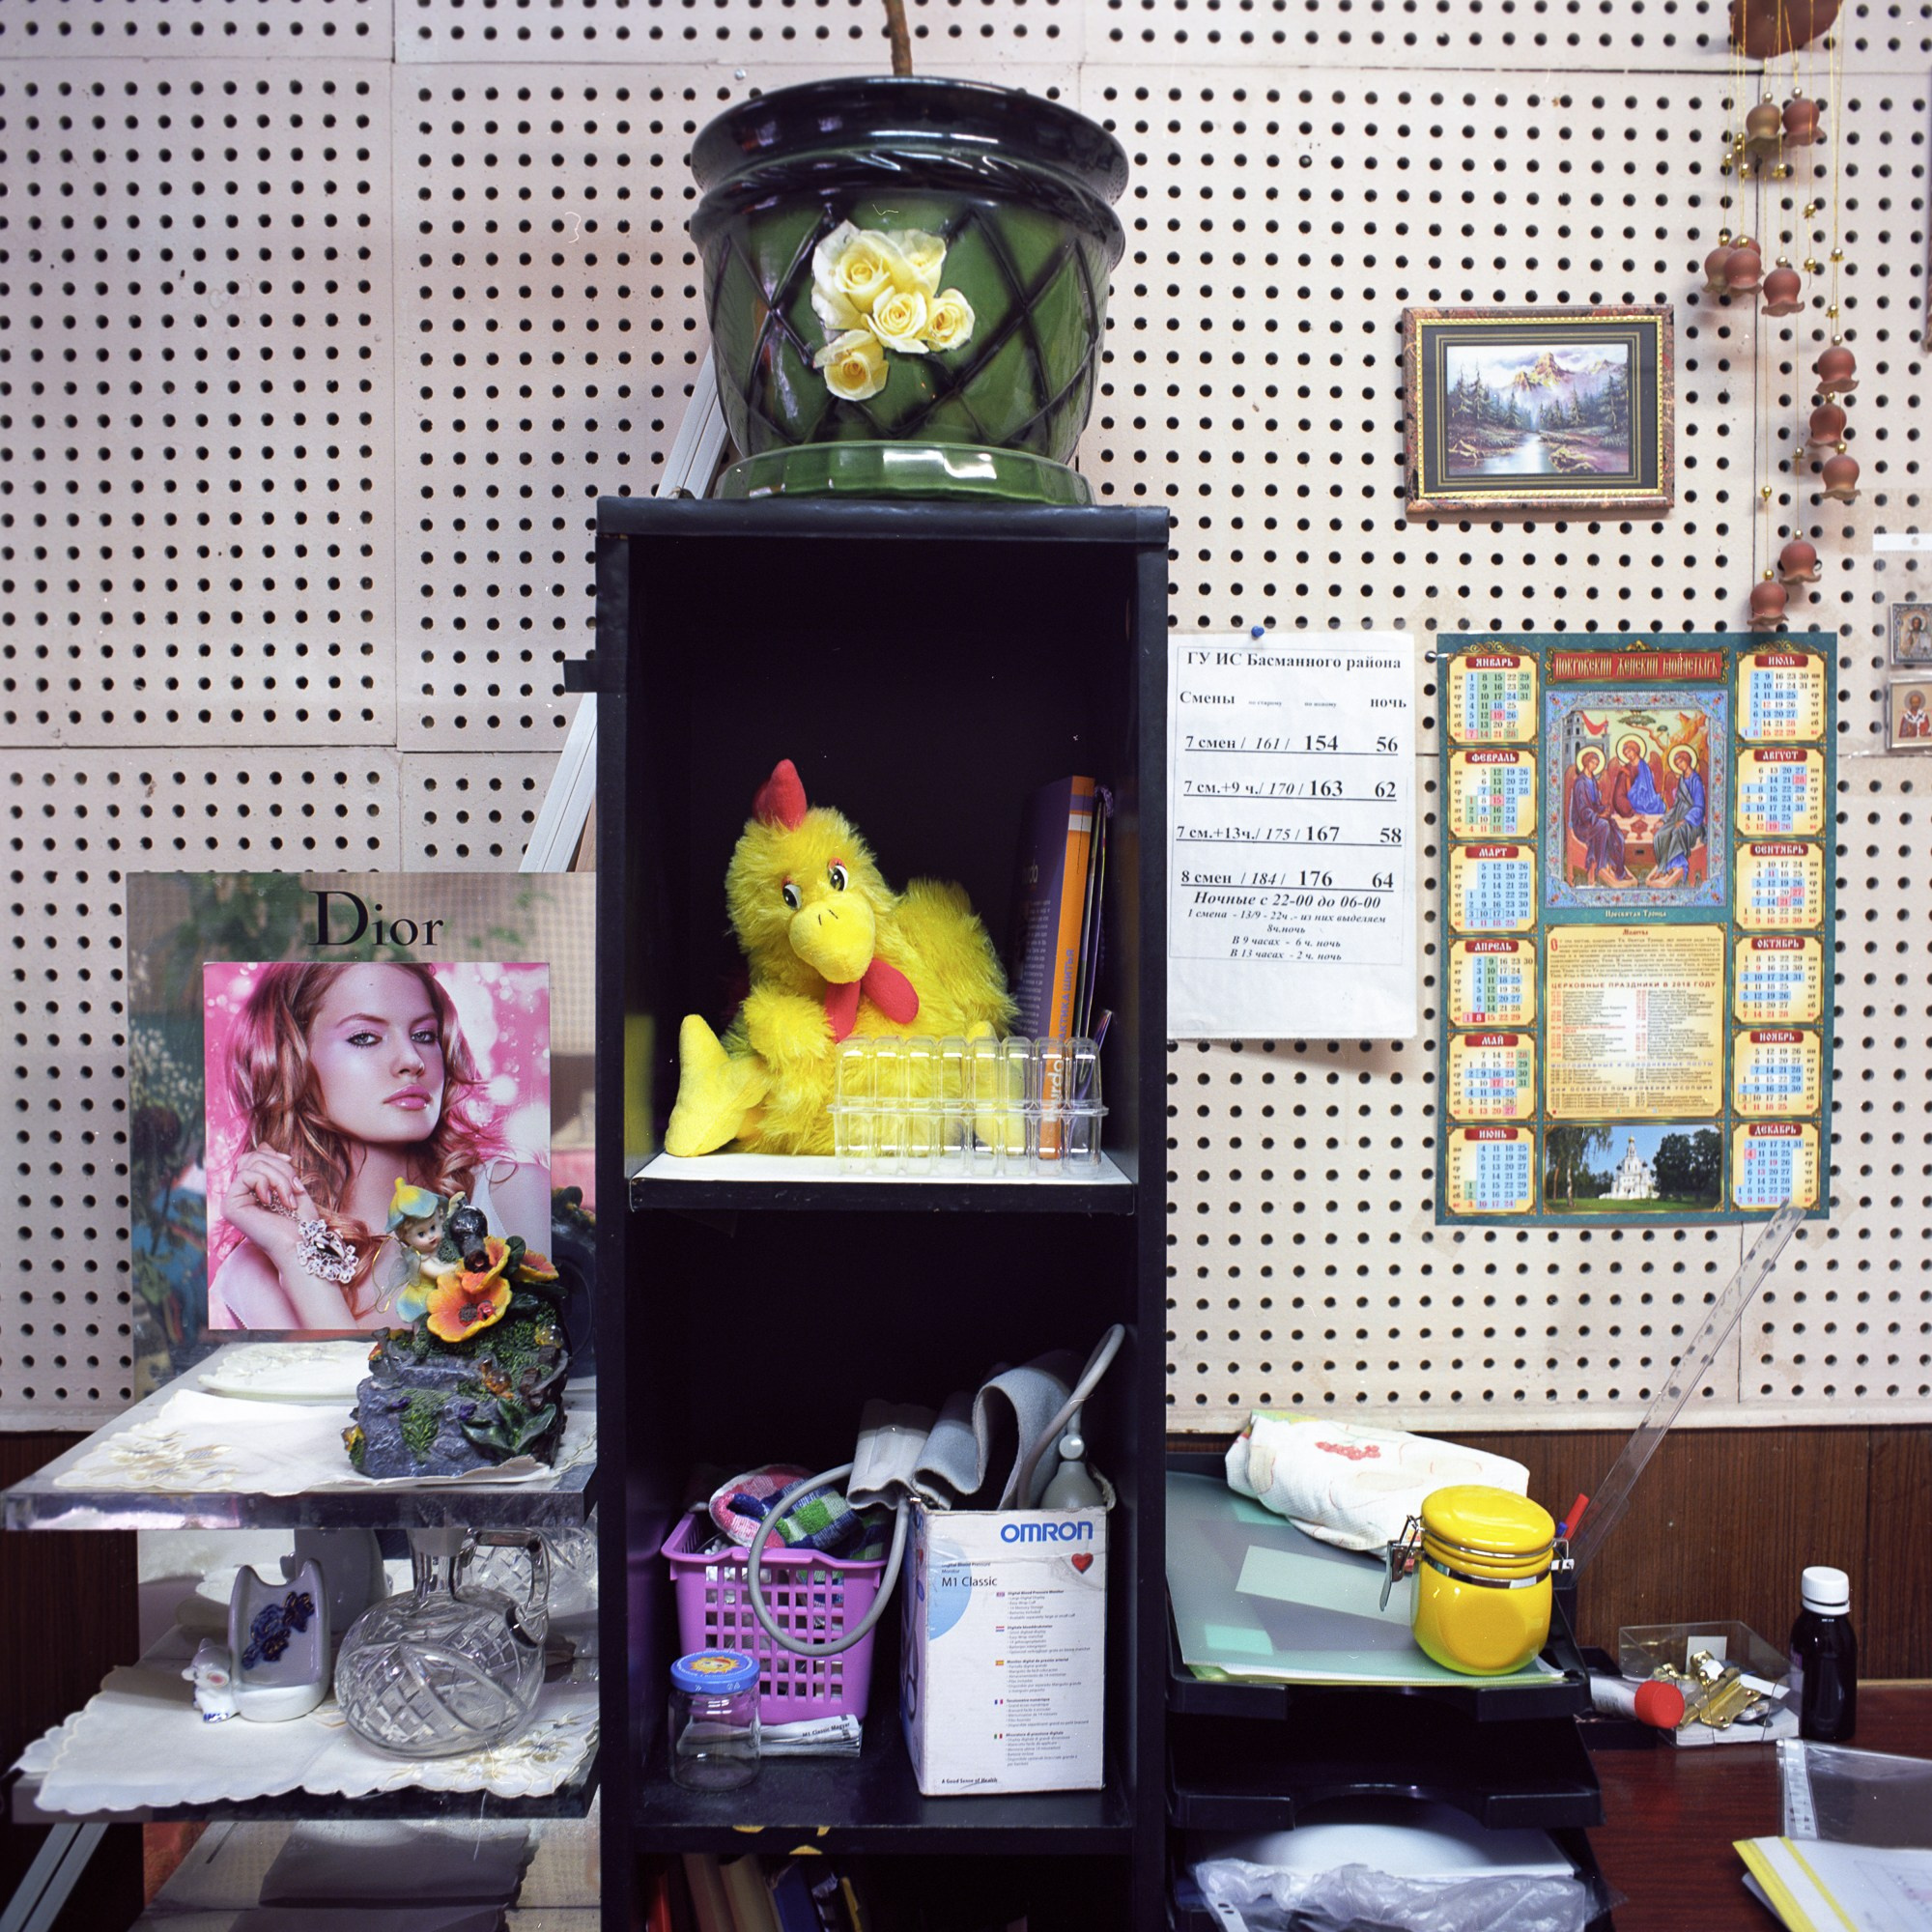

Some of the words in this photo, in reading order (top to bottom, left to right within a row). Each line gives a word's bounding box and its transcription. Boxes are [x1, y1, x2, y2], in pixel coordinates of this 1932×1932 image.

[1187, 652, 1210, 665] ГУ
[1216, 653, 1242, 666] ИС
[1247, 653, 1341, 668] Басманного
[1347, 656, 1401, 671] района
[1475, 658, 1514, 668] ЯНВАРЬ
[1768, 656, 1796, 666] ИЮЛЬ
[1179, 691, 1236, 704] Смены
[1370, 698, 1406, 708] ночь
[1185, 736, 1194, 749] 7
[1199, 738, 1236, 750] смен
[1255, 737, 1280, 751] 161
[1305, 735, 1339, 752] 154
[1376, 736, 1399, 753] 56
[1471, 753, 1516, 762] ФЕВРАЛЬ
[1762, 751, 1799, 760] АВГУСТ
[1184, 781, 1192, 793] 7
[1268, 782, 1294, 795] 170
[1310, 781, 1343, 797] 163
[1375, 781, 1396, 798] 62
[1177, 826, 1185, 838] 7
[1265, 828, 1291, 840] 175
[1306, 826, 1340, 841] 167
[1379, 827, 1402, 843] 58
[1479, 847, 1507, 858] МАРТ
[1754, 844, 1804, 855] СЕНТЯБРЬ
[1181, 870, 1190, 883] 8
[1194, 872, 1232, 885] смен
[1252, 872, 1277, 885] 184
[1299, 870, 1333, 887] 176
[1372, 872, 1394, 888] 64
[1194, 892, 1256, 906] Ночные
[1260, 896, 1268, 906] с
[1272, 894, 1314, 907] 22-00
[1318, 895, 1335, 908] до
[1340, 895, 1381, 909] 06-00
[307, 891, 444, 947] Dior
[1240, 910, 1262, 919] 13/9
[1336, 915, 1386, 923] выделяем
[1232, 935, 1240, 945] В
[1243, 936, 1249, 945] 9
[1295, 938, 1302, 947] 6
[1474, 942, 1512, 952] АПРЕЛЬ
[1757, 938, 1799, 949] ОКТЯБРЬ
[1230, 949, 1238, 957] В
[1296, 951, 1303, 959] 2
[1063, 949, 1074, 993] ШИТЬЯ
[1481, 1035, 1504, 1045] МАЙ
[1759, 1032, 1795, 1042] НОЯБРЬ
[1479, 1129, 1507, 1139] ИЮНЬ
[1754, 1125, 1797, 1137] ДЕКАБРЬ
[1000, 1520, 1094, 1543] OMRON
[942, 1577, 957, 1587] M1
[961, 1576, 998, 1586] Classic
[811, 1726, 830, 1737] Classic
[831, 1721, 850, 1732] Magyar
